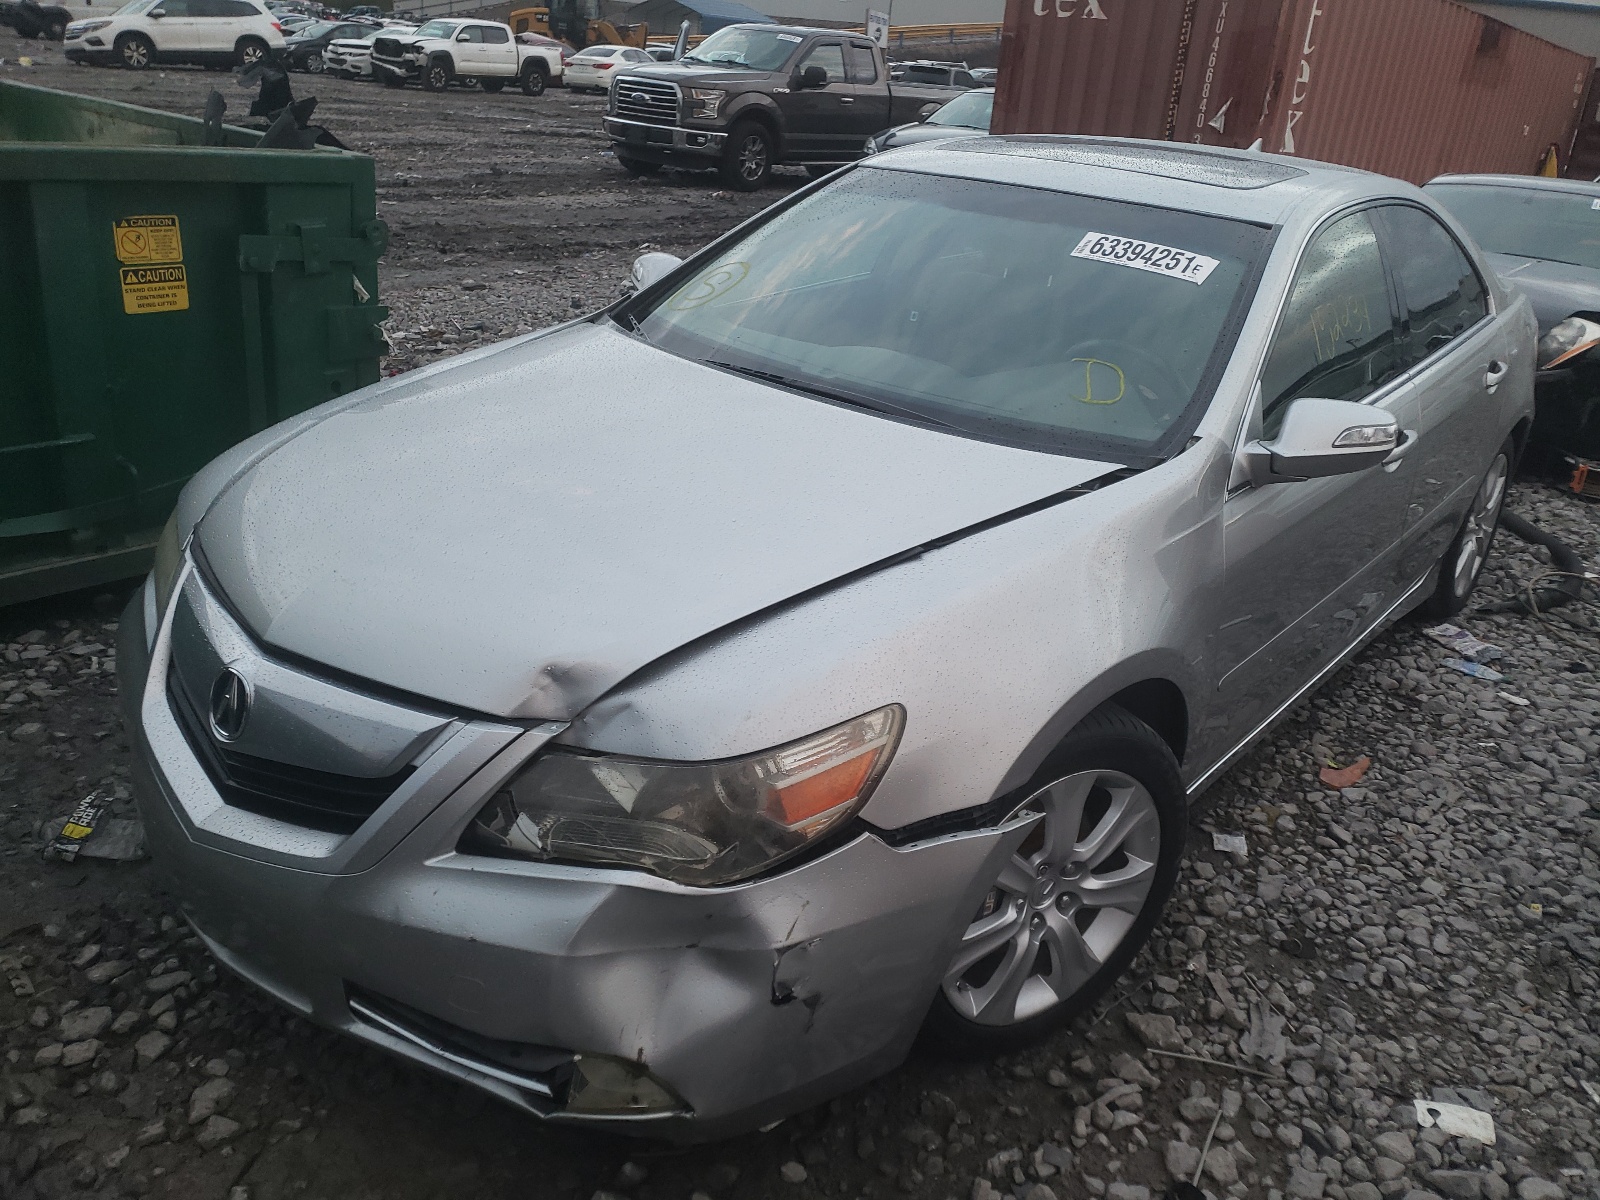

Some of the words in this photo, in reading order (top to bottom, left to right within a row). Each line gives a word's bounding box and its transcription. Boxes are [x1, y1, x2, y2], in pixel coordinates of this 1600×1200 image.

[130, 218, 172, 227] CAUTION
[1089, 236, 1197, 274] 63394251
[138, 268, 183, 283] CAUTION
[1070, 357, 1125, 405] D
